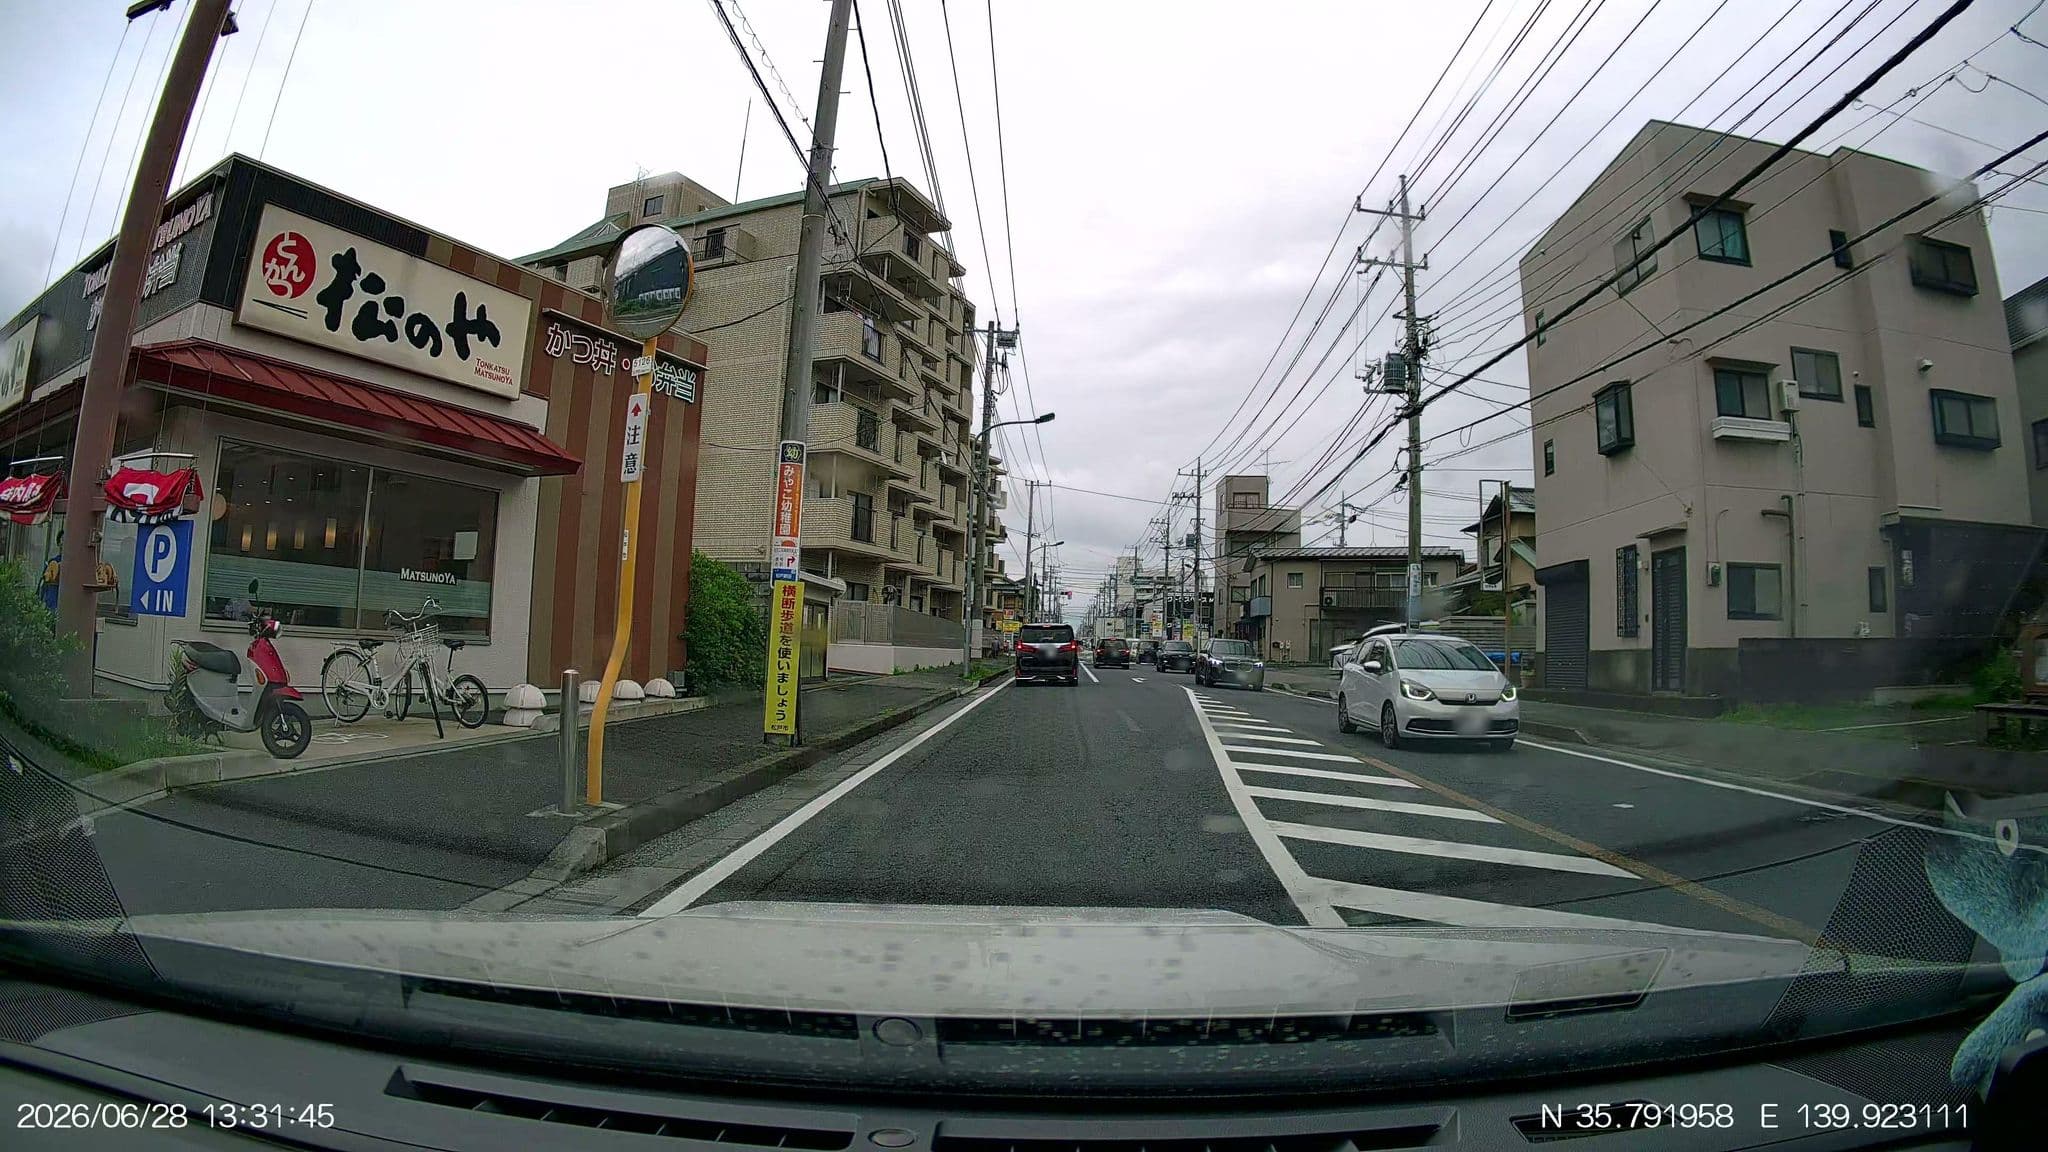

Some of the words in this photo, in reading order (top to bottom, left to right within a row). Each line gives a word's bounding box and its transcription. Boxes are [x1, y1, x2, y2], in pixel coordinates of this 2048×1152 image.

[316, 247, 500, 361] 松のや
[474, 366, 513, 385] MATSUNOYA
[476, 357, 511, 376] TONKATSU
[623, 425, 641, 474] 注意
[151, 533, 171, 575] P
[400, 567, 456, 585] MATSUNOYA
[155, 590, 174, 612] IN
[775, 584, 797, 721] 横断歩道を使いましょう
